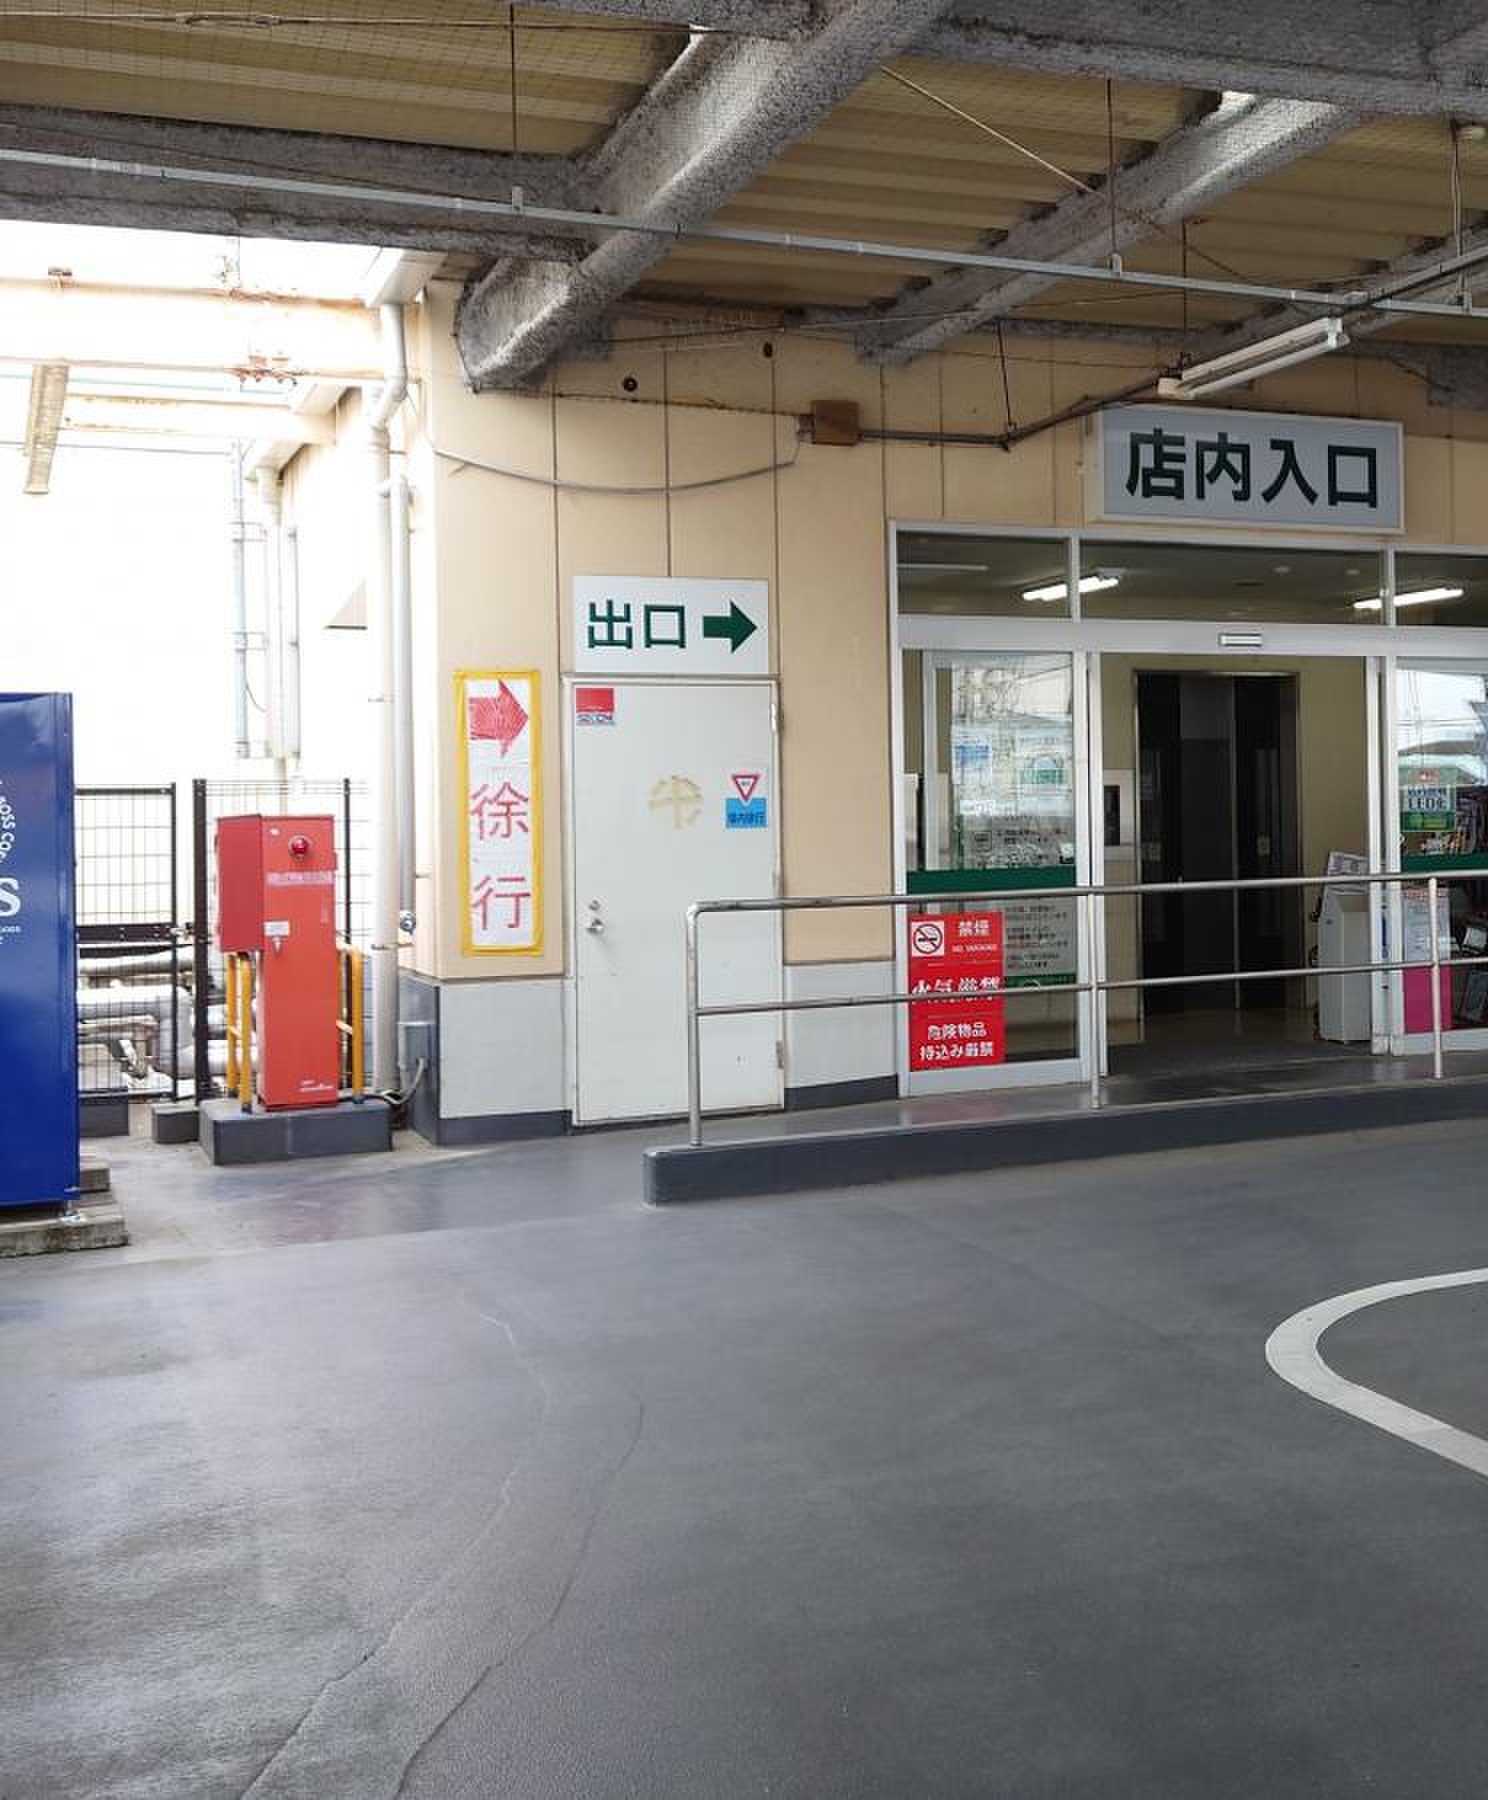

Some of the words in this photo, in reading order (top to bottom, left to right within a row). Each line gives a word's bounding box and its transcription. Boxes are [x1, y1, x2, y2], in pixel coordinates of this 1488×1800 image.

[1126, 428, 1377, 508] 店内入口
[588, 599, 686, 649] 出口
[470, 781, 530, 930] 徐行
[958, 918, 990, 937] 禁煙
[927, 1022, 987, 1041] 危険物品
